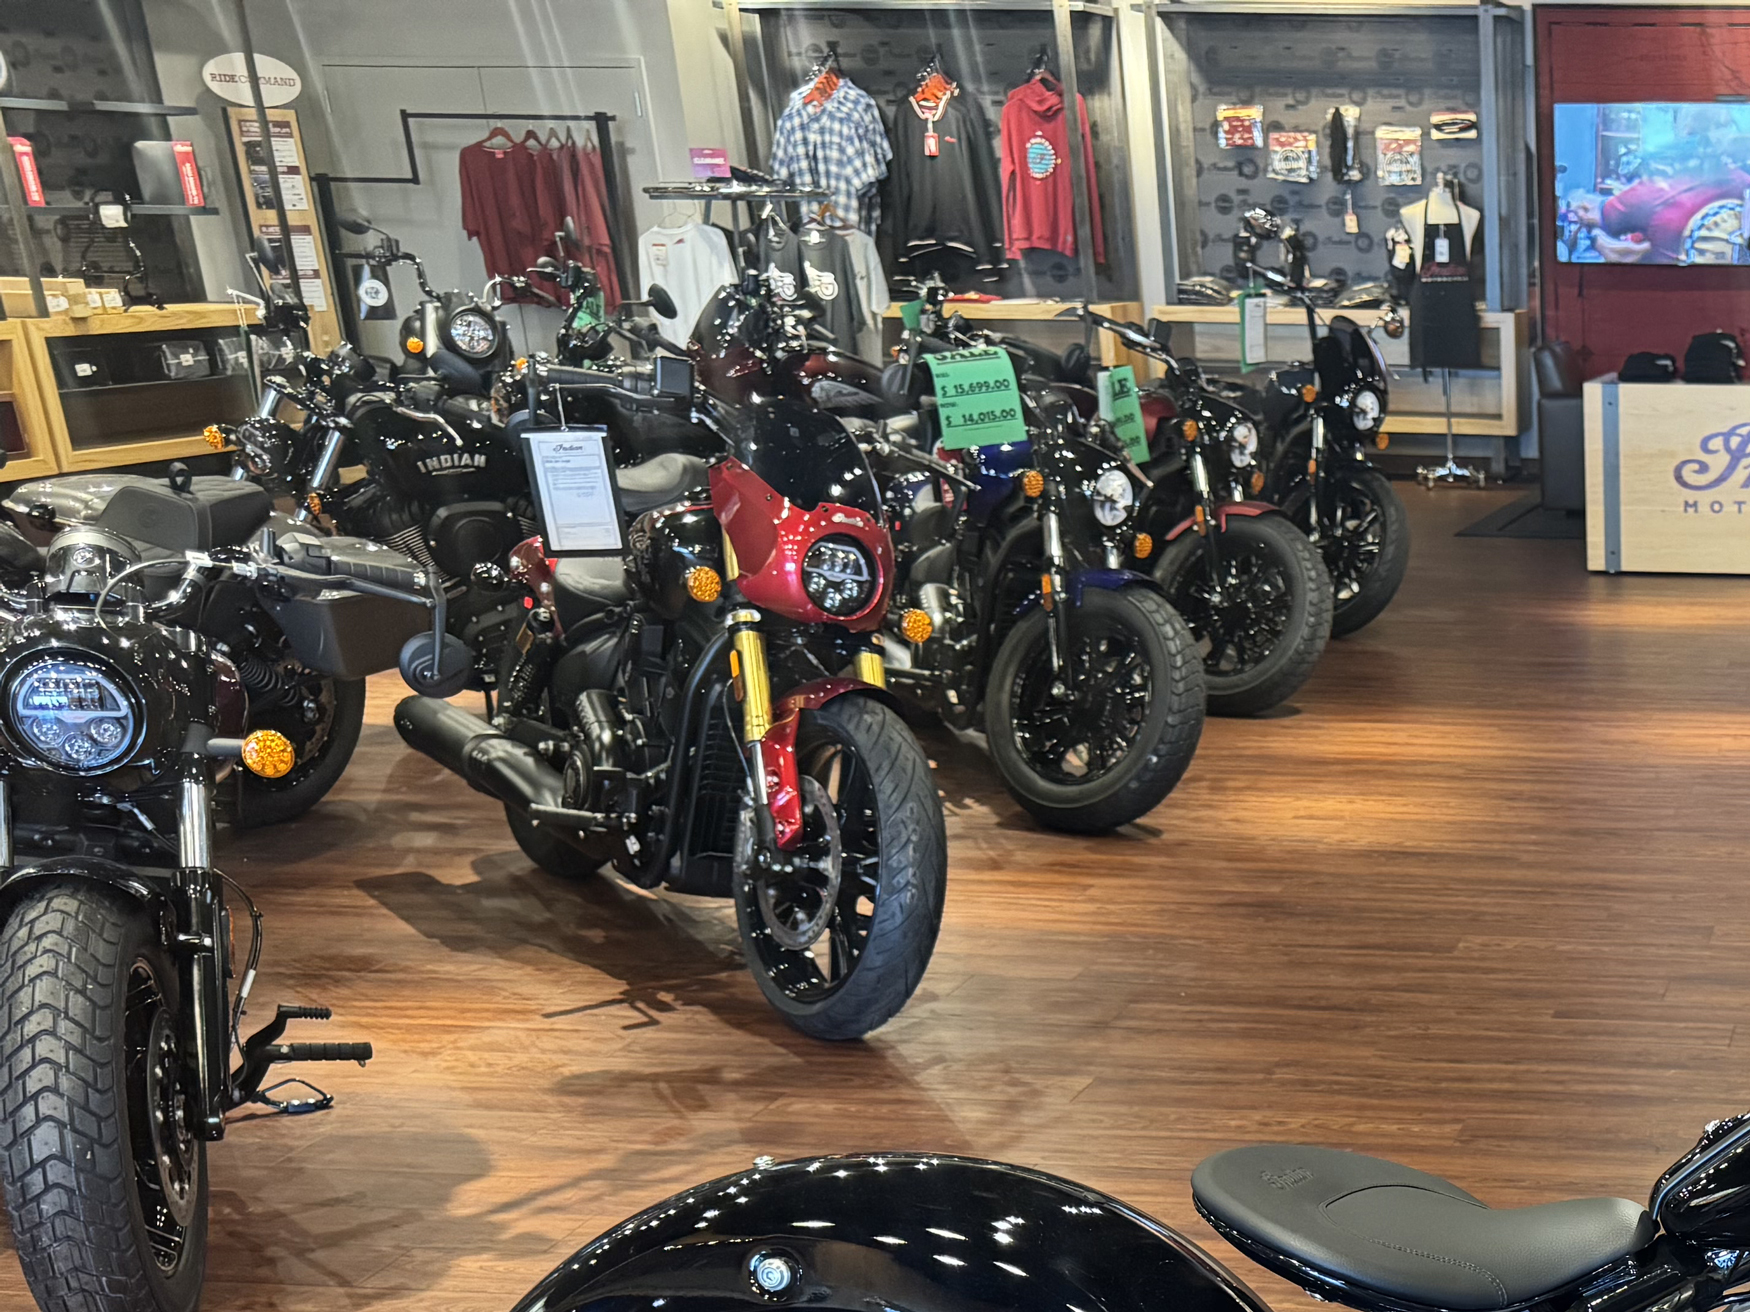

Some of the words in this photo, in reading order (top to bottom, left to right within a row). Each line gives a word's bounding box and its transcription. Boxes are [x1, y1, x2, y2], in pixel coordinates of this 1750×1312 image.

[953, 379, 1010, 395] 15,699.00
[962, 408, 1017, 424] 14,015.00
[416, 453, 488, 474] INDIAN
